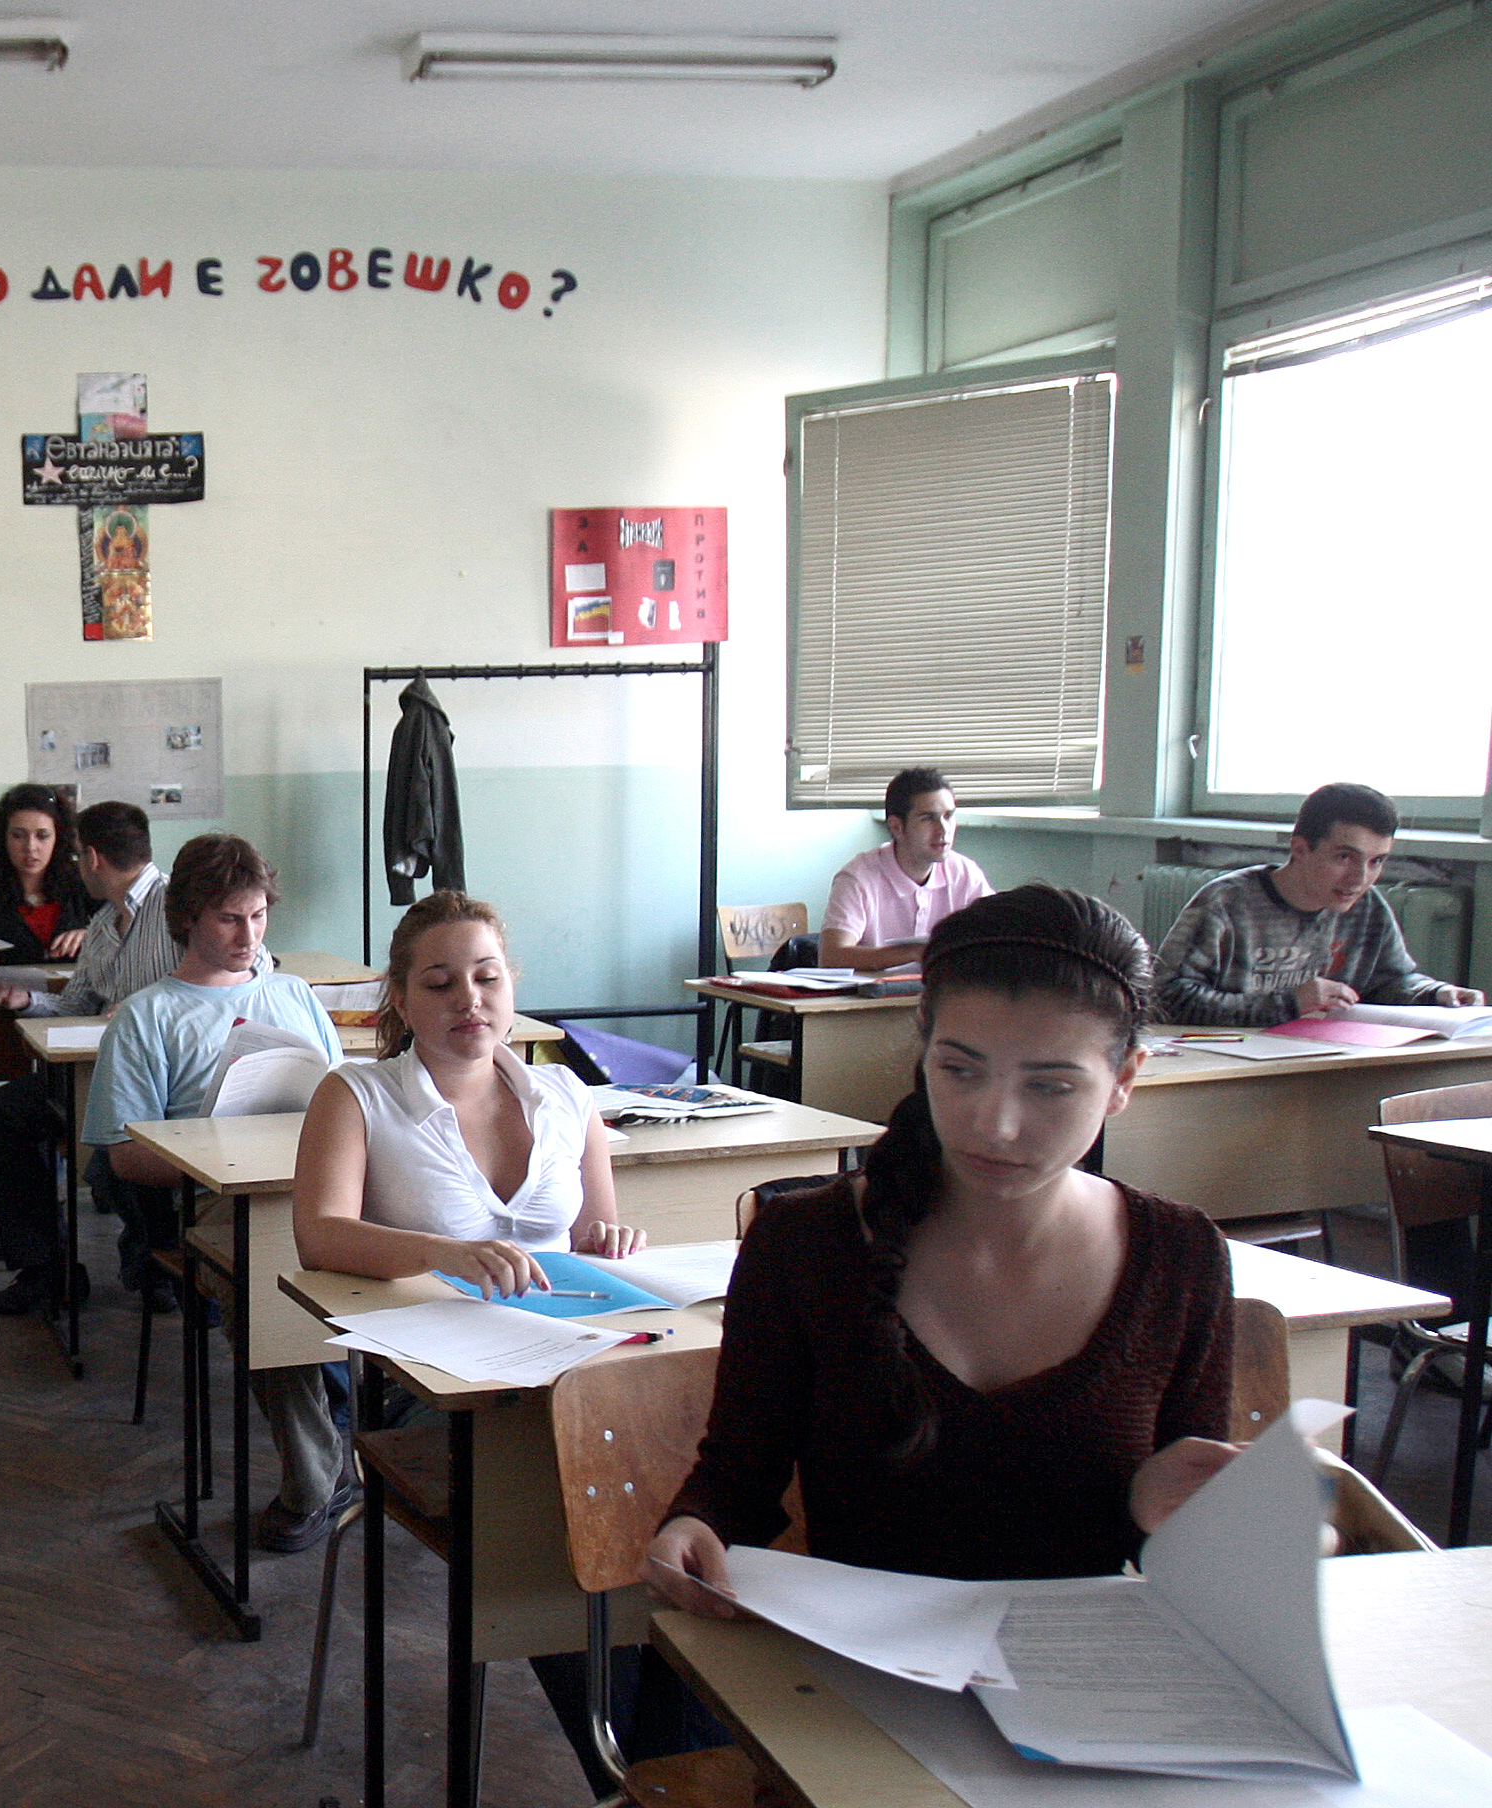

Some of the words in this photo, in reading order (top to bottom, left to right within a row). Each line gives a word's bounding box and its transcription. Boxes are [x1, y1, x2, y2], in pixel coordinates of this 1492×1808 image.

[31, 257, 173, 302] ДАЛИ
[196, 258, 223, 297] Е
[257, 248, 578, 318] ЧОВЕШКО?
[1252, 969, 1319, 992] ORIGINA
